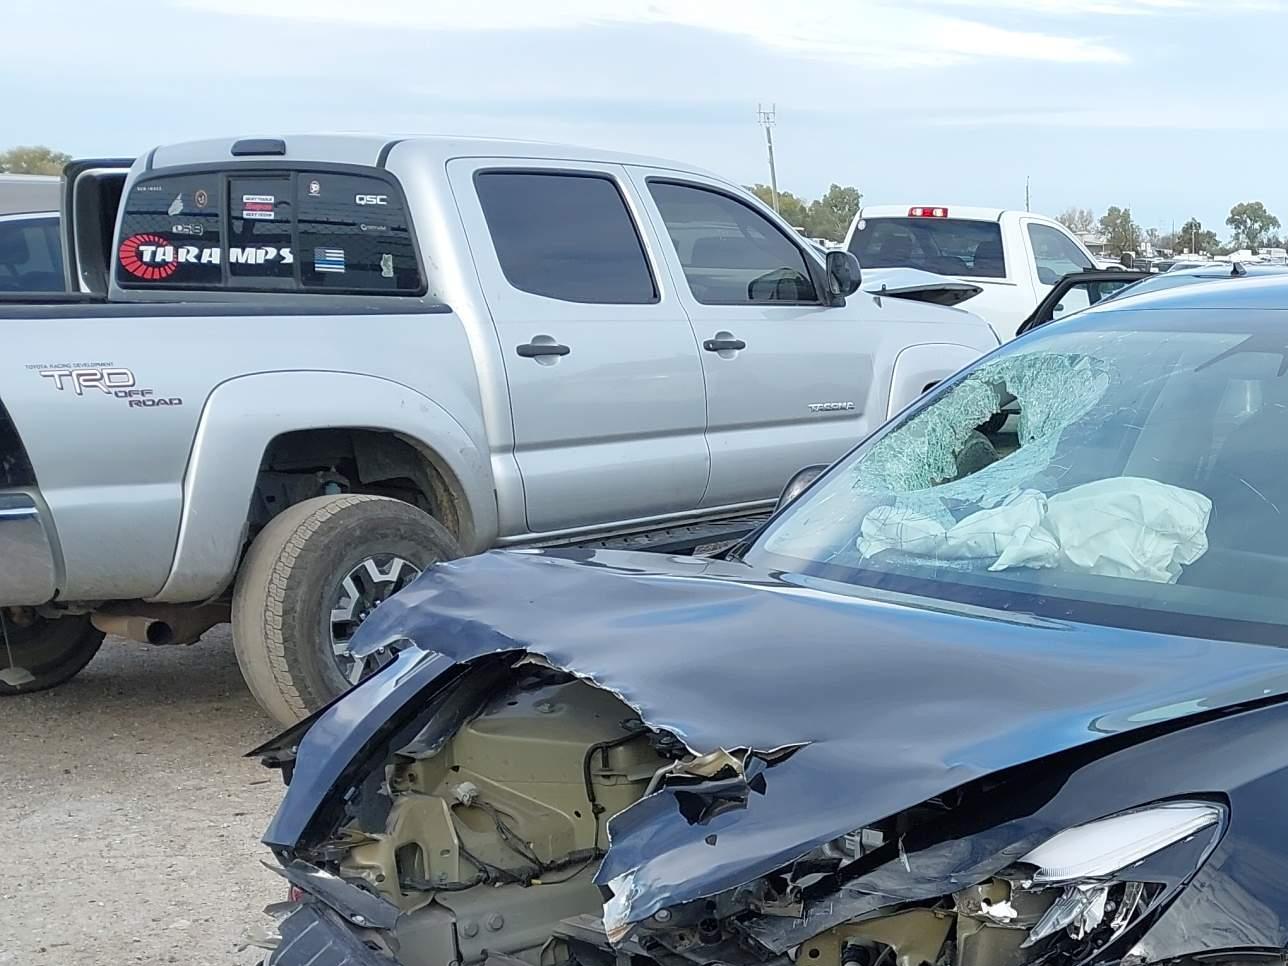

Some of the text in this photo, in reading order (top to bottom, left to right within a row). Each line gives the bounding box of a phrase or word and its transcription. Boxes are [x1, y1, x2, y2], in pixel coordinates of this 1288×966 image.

[355, 194, 388, 205] QSC
[138, 245, 294, 265] TARAMPS
[39, 367, 136, 396] TRD
[113, 389, 153, 399] OFF
[128, 397, 183, 408] ROAD
